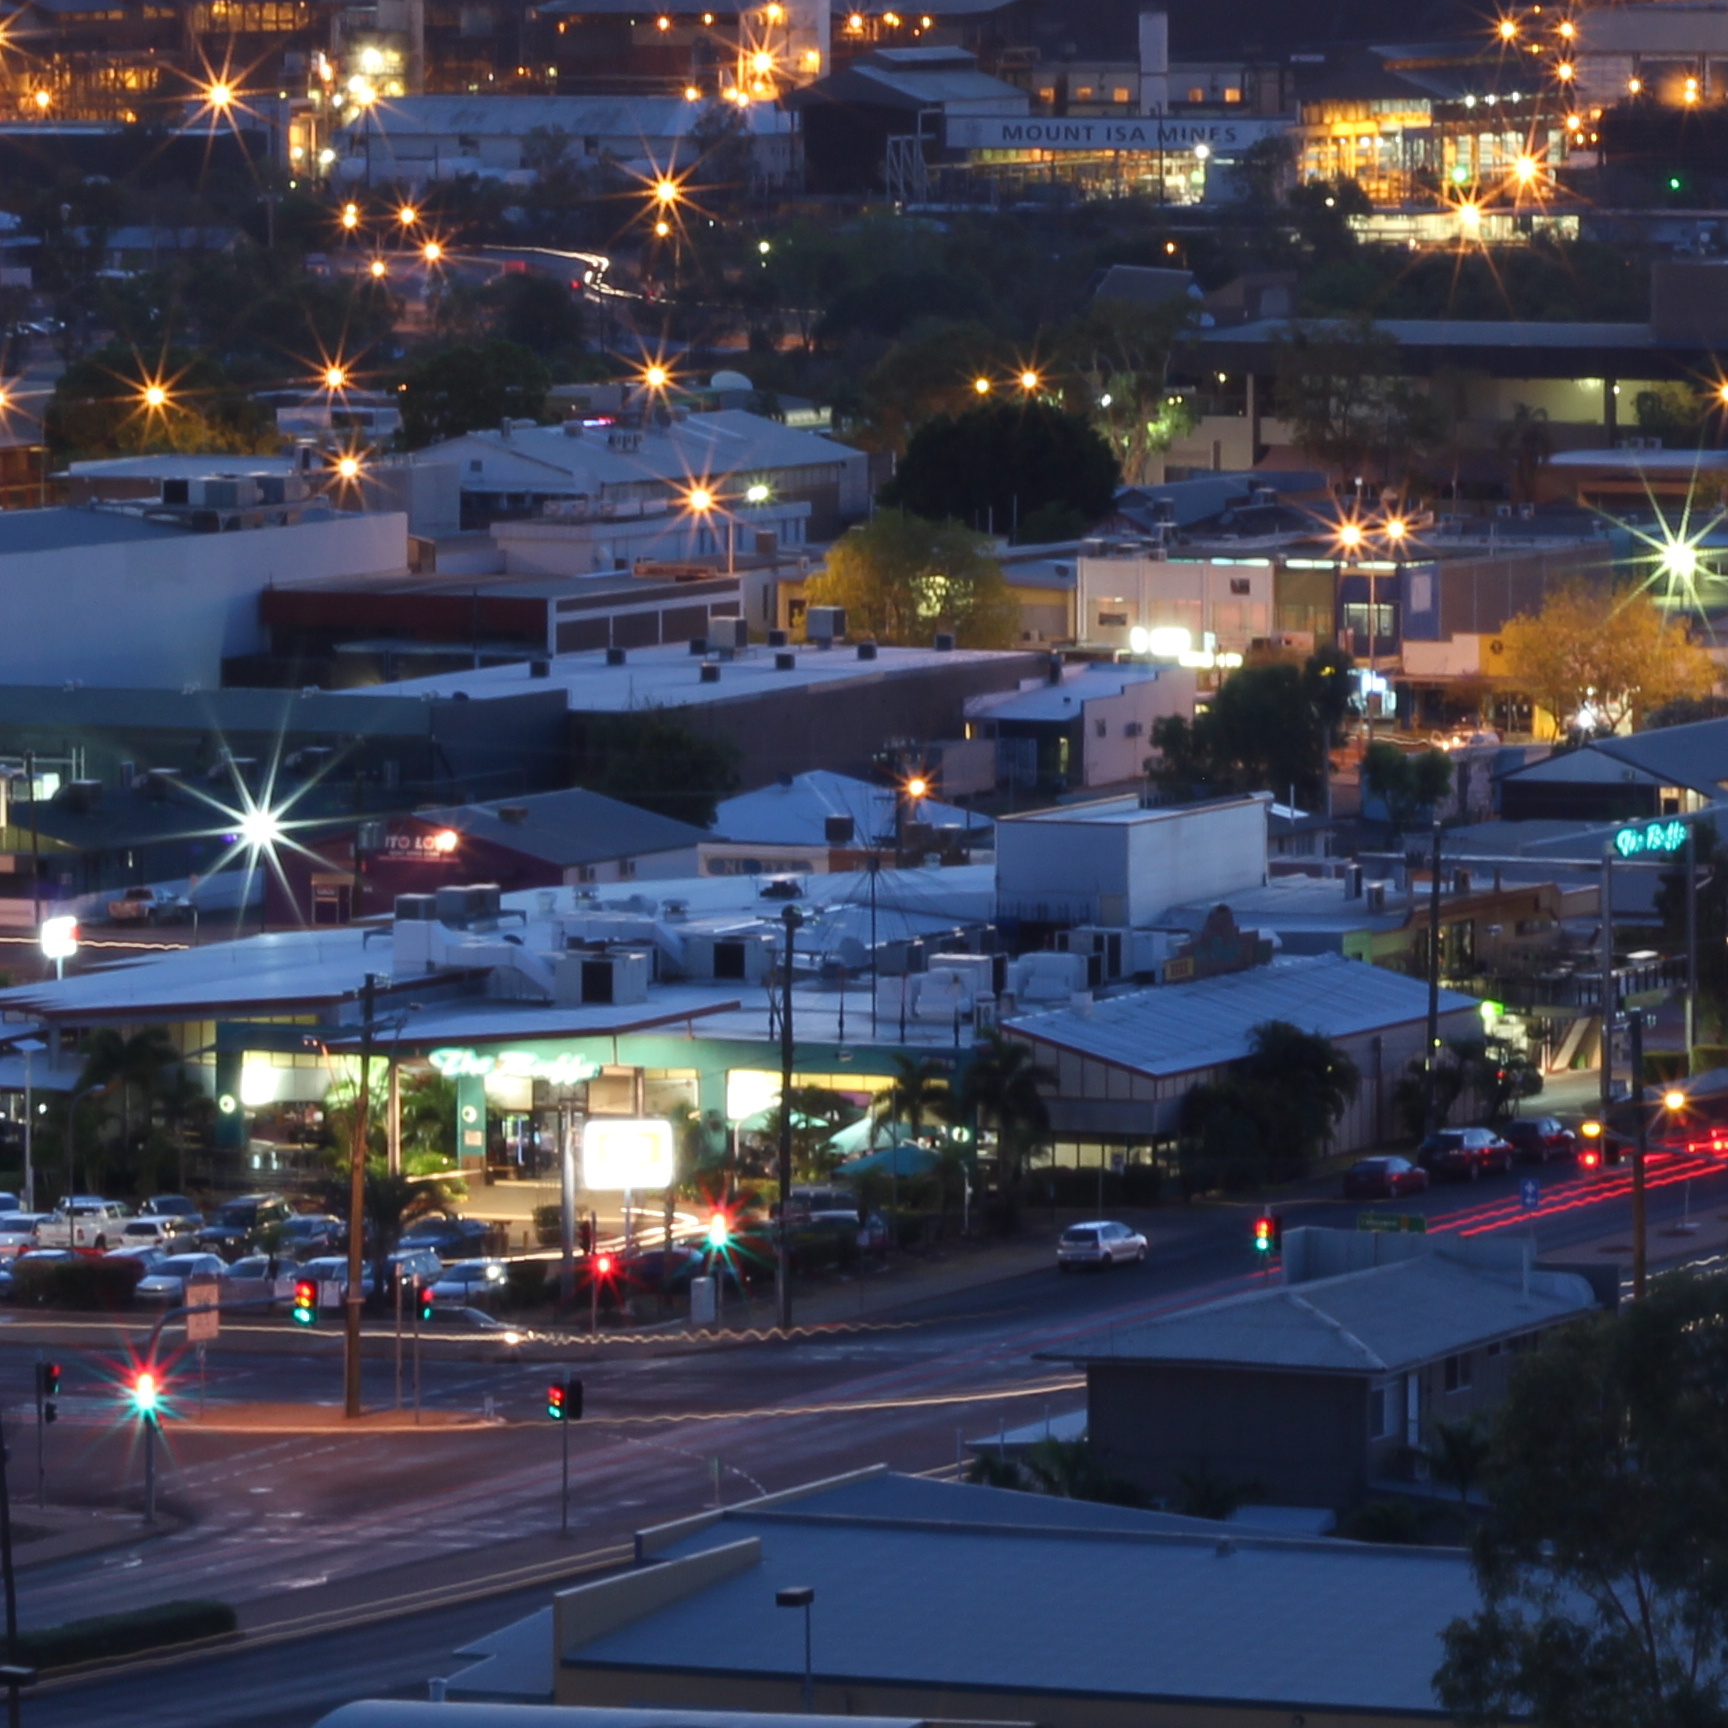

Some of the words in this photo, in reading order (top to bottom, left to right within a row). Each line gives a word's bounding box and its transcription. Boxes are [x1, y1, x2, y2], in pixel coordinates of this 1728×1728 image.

[1002, 124, 1096, 141] MOUNT
[1106, 125, 1146, 141] ISA
[1157, 126, 1237, 143] MINES
